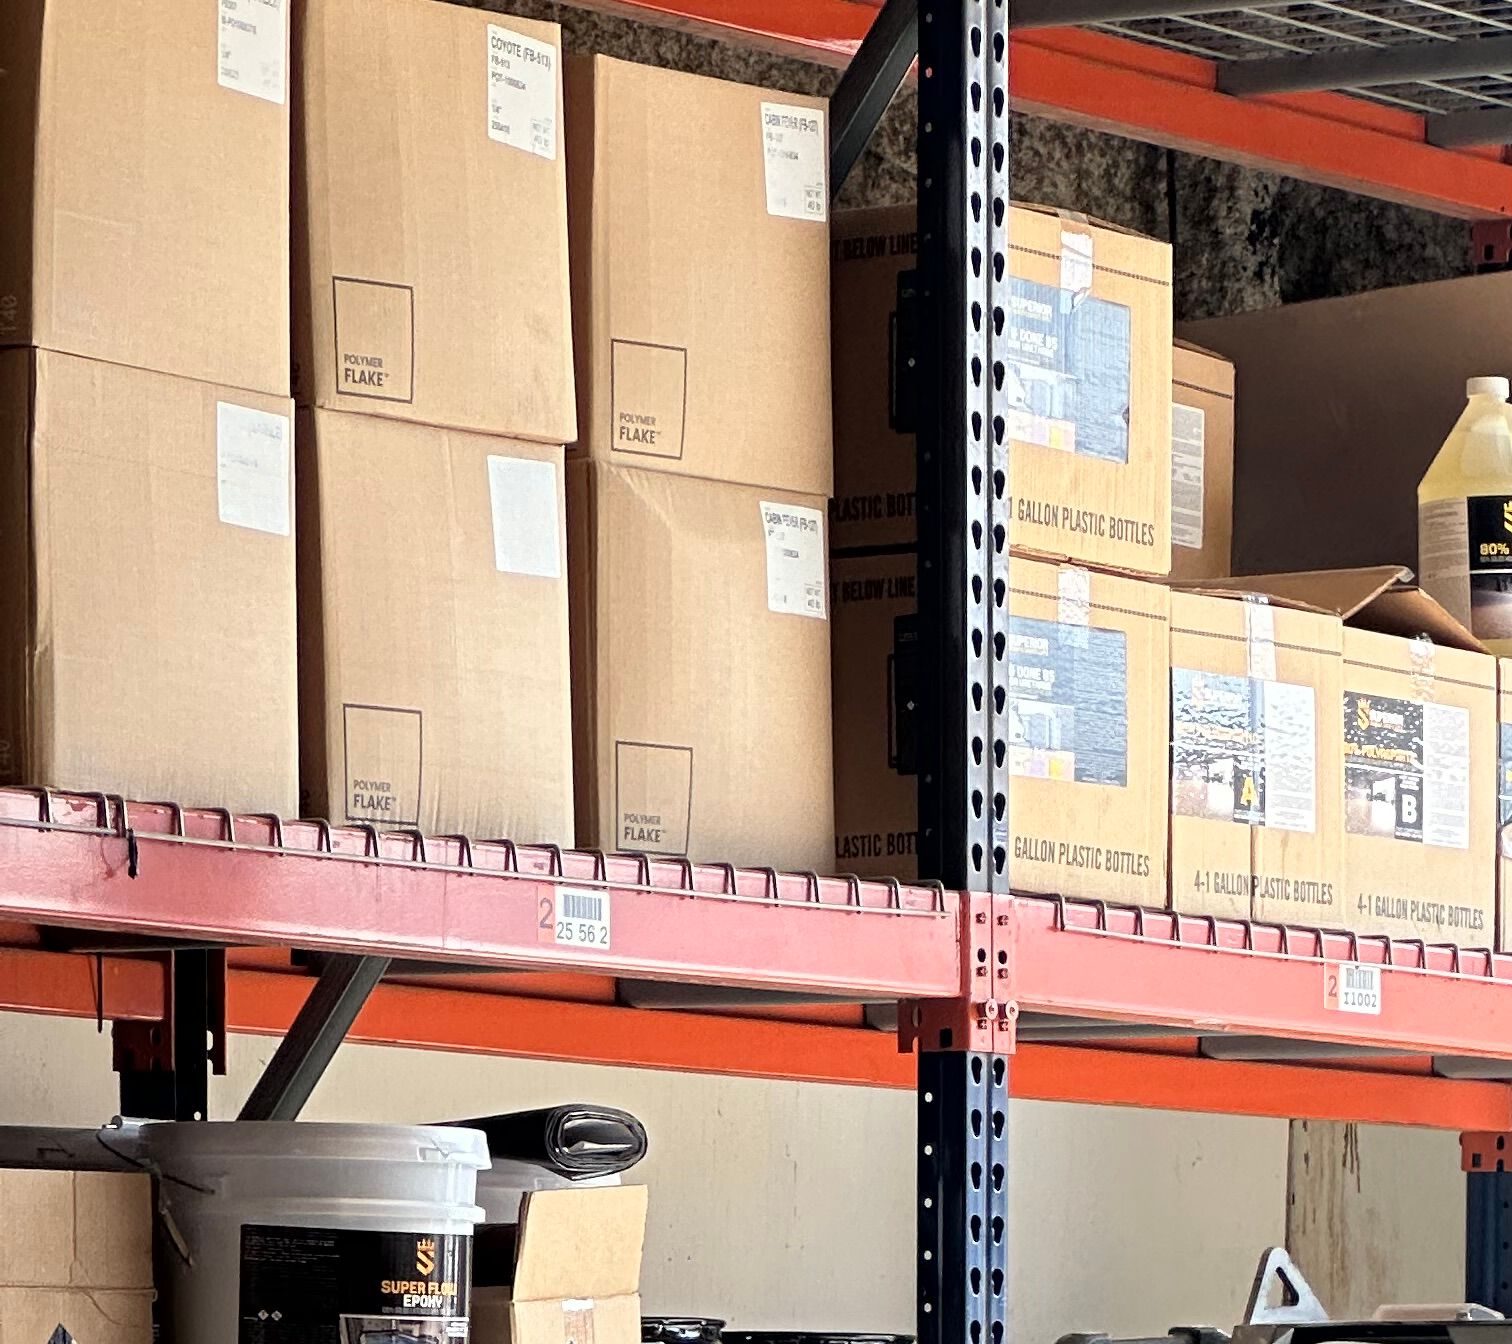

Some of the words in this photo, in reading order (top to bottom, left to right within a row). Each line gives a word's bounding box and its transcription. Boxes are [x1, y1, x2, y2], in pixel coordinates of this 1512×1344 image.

[491, 36, 521, 58] COYOTE
[844, 235, 886, 260] BELOW
[344, 354, 383, 368] POLYMER
[620, 412, 656, 426] POLYMER
[1018, 498, 1058, 528] GALLON
[1062, 507, 1105, 537] PLASTIC
[1109, 516, 1155, 547] BOTTLES
[842, 579, 884, 601] BELOW
[888, 576, 915, 598] LINE
[353, 779, 391, 793] POLYMER
[624, 812, 661, 825] POLYMER
[1402, 794, 1418, 823] B
[836, 834, 882, 857] LASTIC
[887, 832, 919, 856] BOTT
[1015, 836, 1055, 863] GALLON
[1059, 843, 1102, 869] PLASTIC
[1106, 849, 1150, 877] BOTTLES
[1194, 870, 1210, 892] 4-1
[1214, 871, 1249, 896] GALLON
[1252, 875, 1290, 901] PLASTIC
[1293, 880, 1333, 905] BOTTLES
[540, 897, 553, 929] 2
[1357, 893, 1372, 915] 4-1
[1375, 896, 1408, 920] GALLON
[1410, 900, 1445, 926] PLASTIC
[1448, 905, 1484, 930] BOTTLES
[1328, 975, 1337, 998] 2
[381, 1280, 425, 1296] SUPER
[403, 1294, 443, 1308] EPOXY
